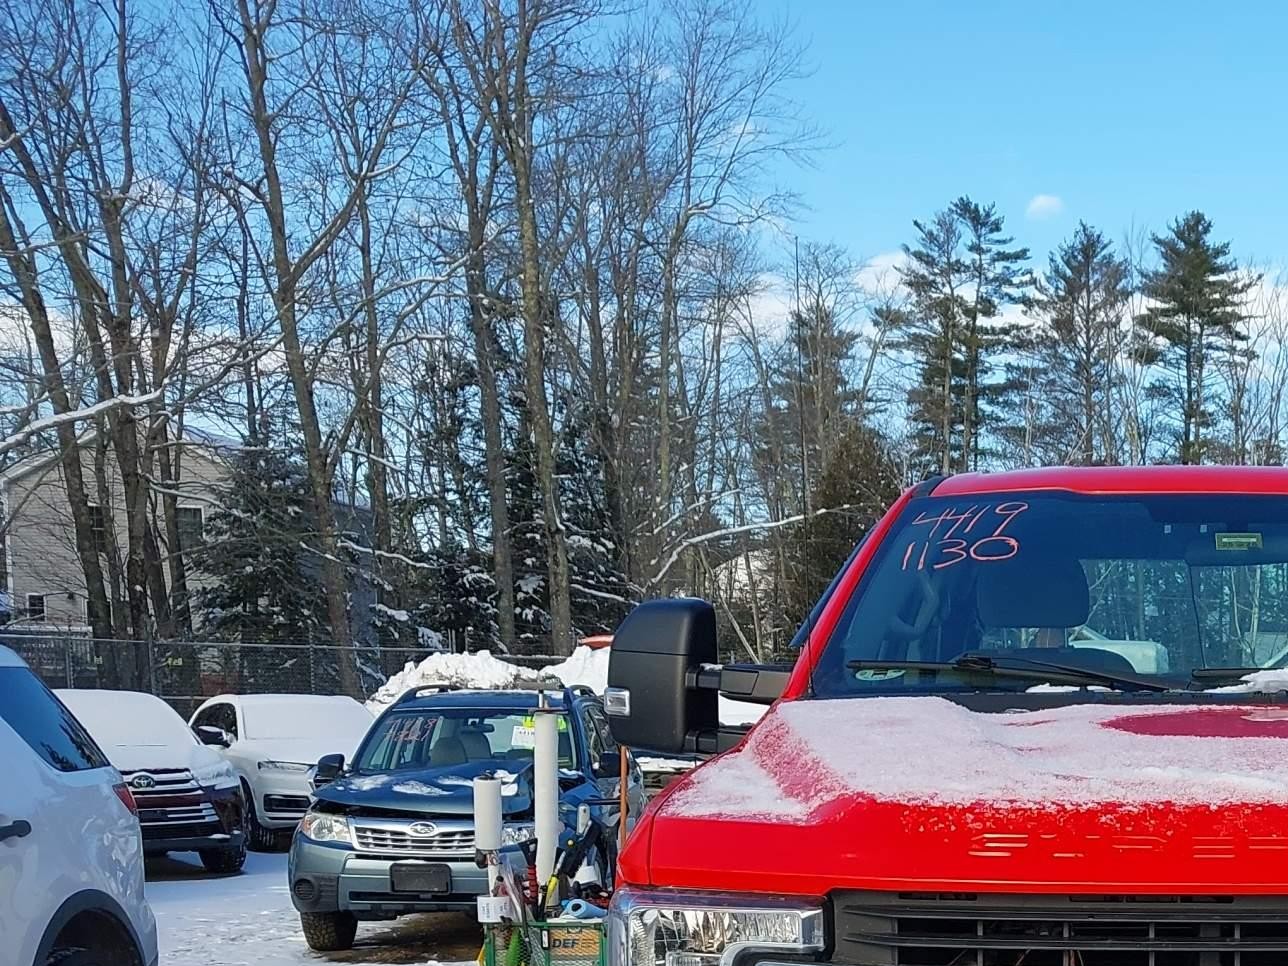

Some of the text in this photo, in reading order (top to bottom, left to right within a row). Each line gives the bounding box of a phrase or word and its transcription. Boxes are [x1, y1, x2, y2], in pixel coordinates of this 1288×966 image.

[911, 501, 1029, 540] 4419
[901, 536, 1019, 570] 1130
[551, 938, 579, 948] DEF
